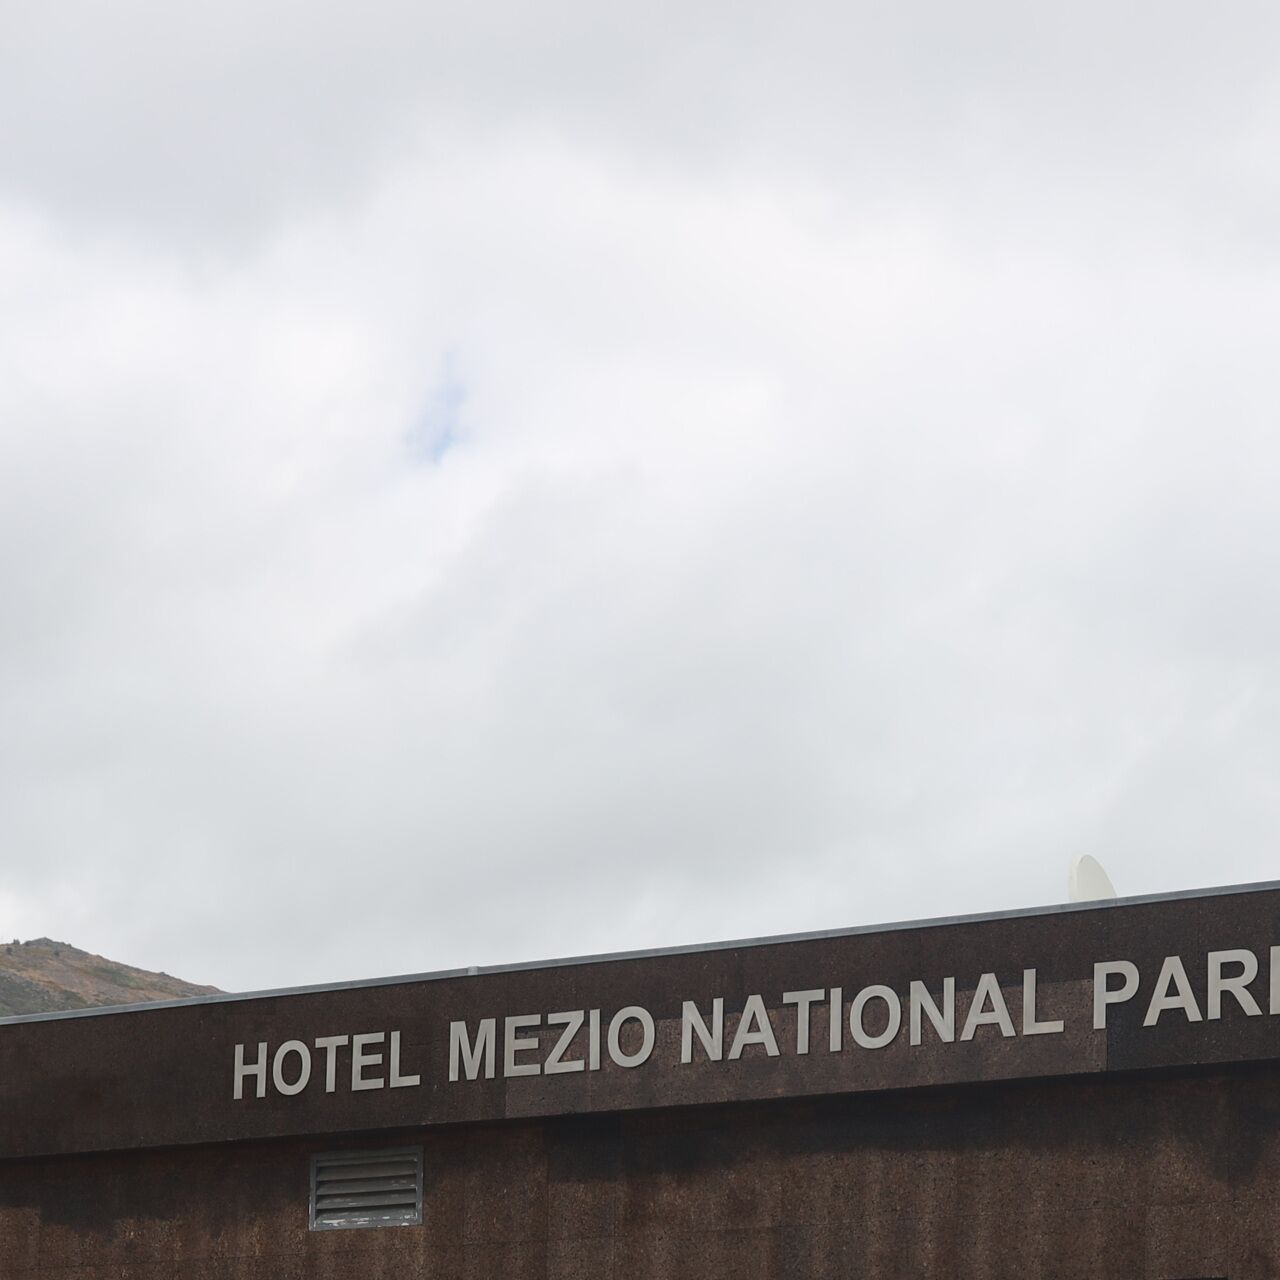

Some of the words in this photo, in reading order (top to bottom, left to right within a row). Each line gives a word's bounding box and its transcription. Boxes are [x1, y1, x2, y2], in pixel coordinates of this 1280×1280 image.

[233, 1030, 421, 1100] HOTEL
[449, 1005, 656, 1082] MEZIO
[681, 968, 1065, 1064] NATIONAL
